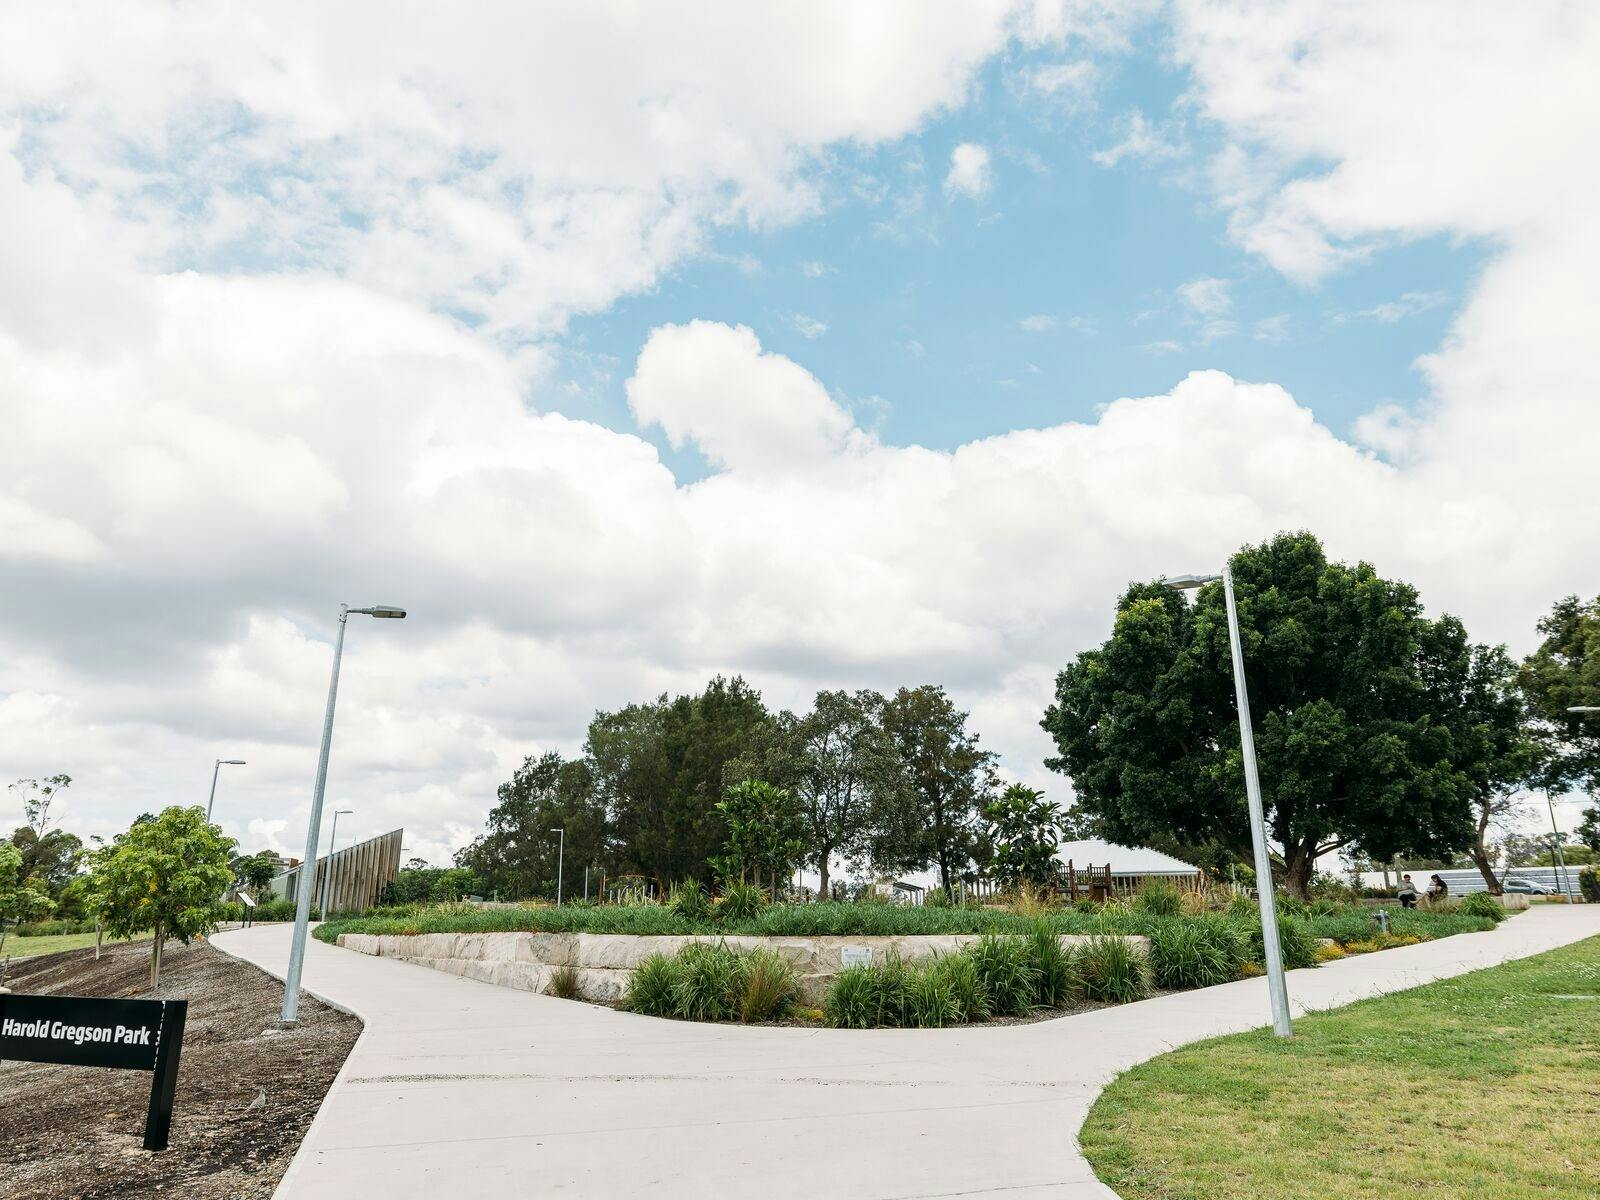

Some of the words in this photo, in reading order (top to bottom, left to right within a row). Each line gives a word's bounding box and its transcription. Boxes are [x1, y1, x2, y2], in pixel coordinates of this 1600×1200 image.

[1, 1018, 49, 1038] Harold
[51, 1021, 112, 1045] Gregson
[113, 1026, 151, 1045] Park
